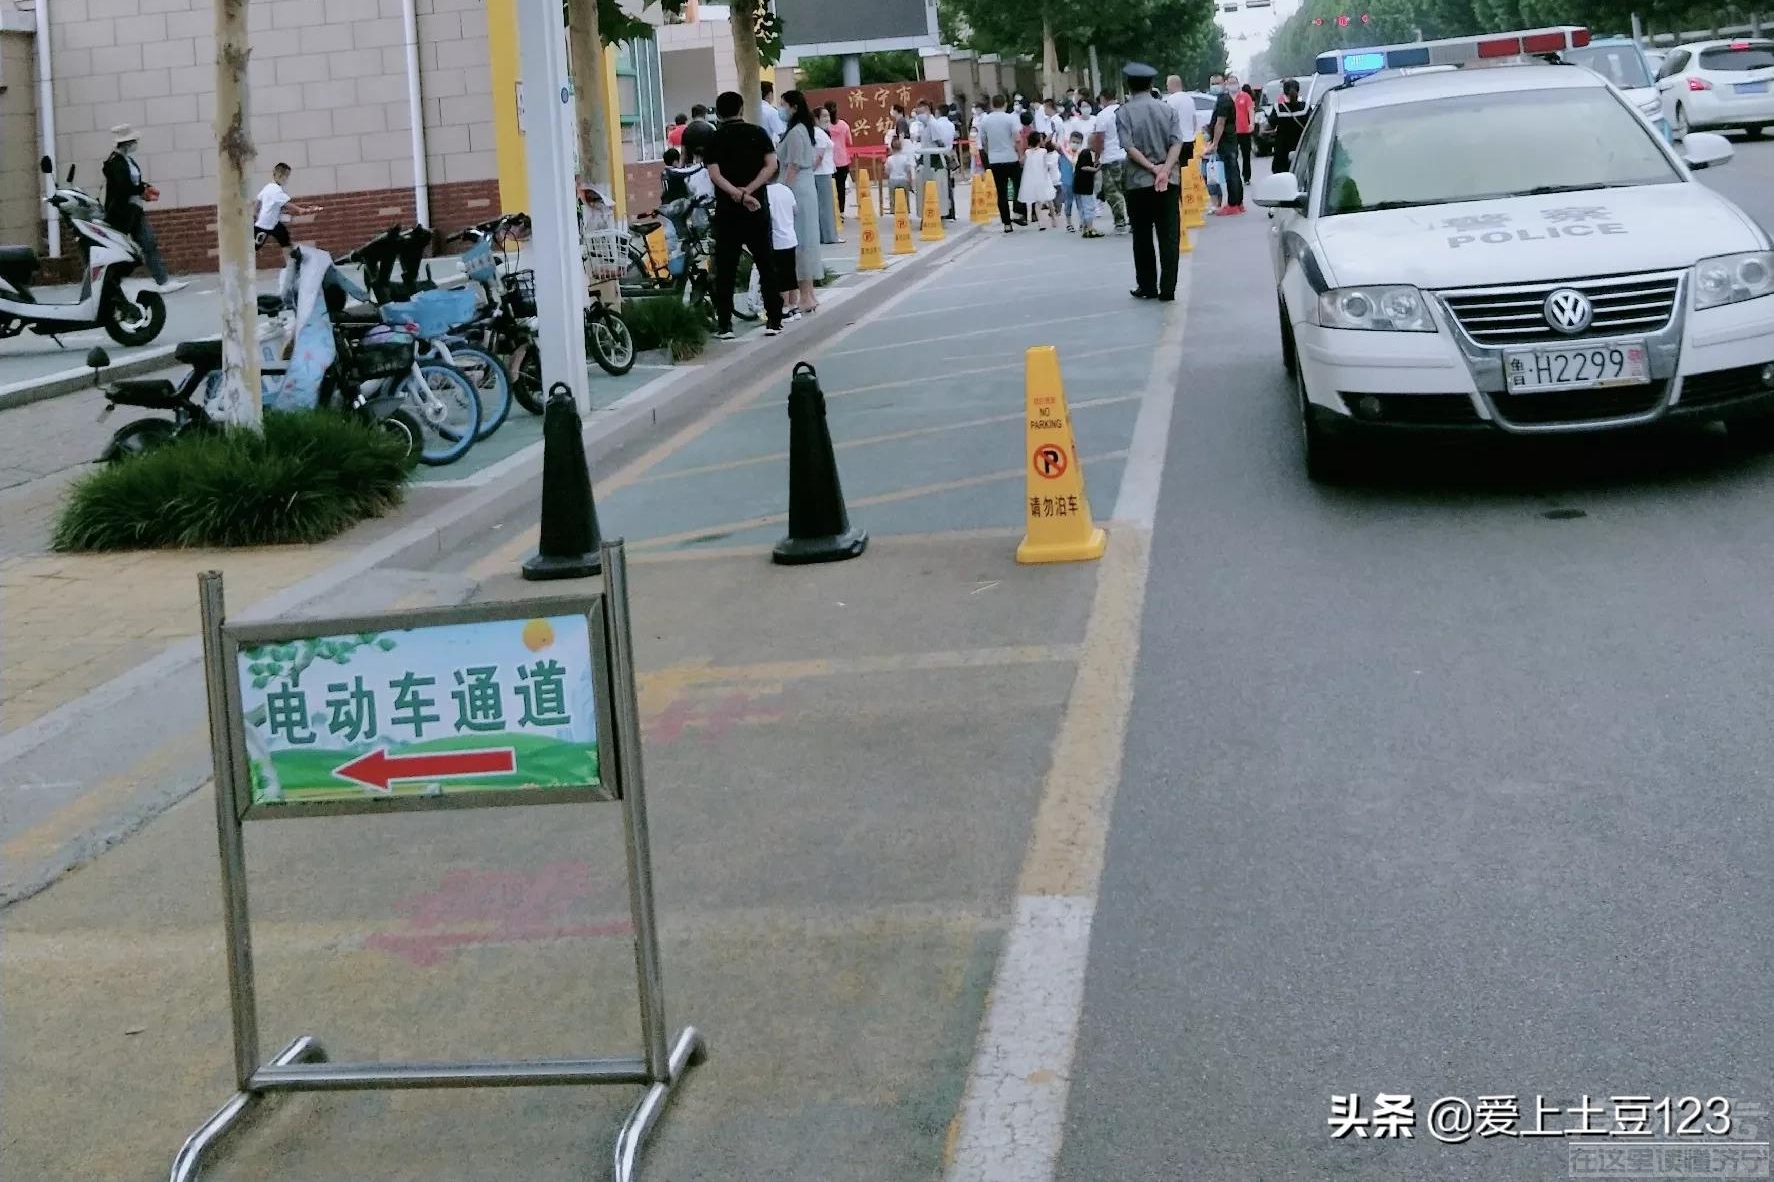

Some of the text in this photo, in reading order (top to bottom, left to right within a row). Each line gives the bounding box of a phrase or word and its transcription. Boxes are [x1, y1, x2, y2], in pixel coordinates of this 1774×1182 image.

[848, 85, 912, 110] 济宁市
[1441, 206, 1612, 232] 警察
[1447, 223, 1629, 249] POLICE
[1030, 419, 1062, 430] PARKING
[1040, 407, 1050, 417] NO
[1029, 494, 1078, 517] 请勿泊车
[266, 658, 572, 746] 电动车通道
